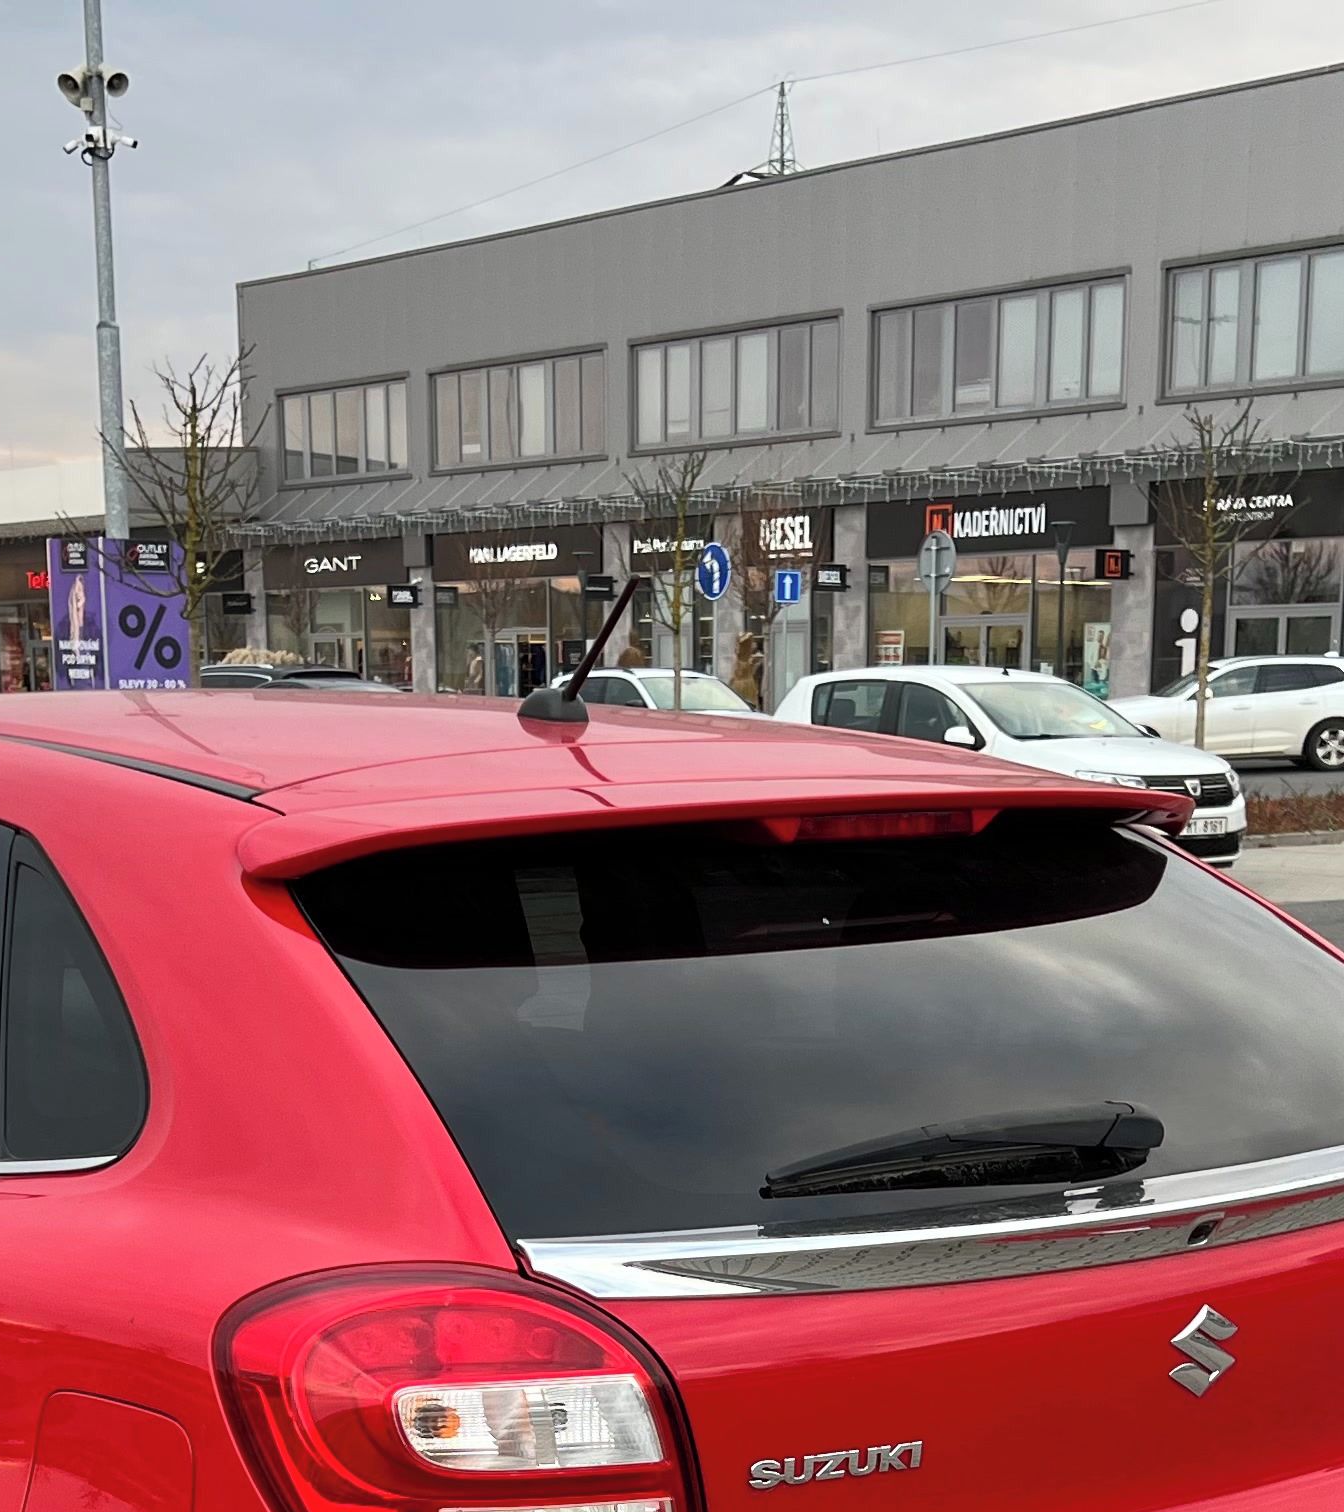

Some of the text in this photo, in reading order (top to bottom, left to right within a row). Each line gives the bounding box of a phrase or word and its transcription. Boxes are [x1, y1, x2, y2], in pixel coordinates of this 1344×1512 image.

[953, 502, 1047, 539] KADEŘNICTVÍ
[1248, 494, 1295, 510] CENTRA
[759, 515, 814, 552] DIESEL
[303, 555, 362, 574] GANT
[497, 543, 558, 562] LAGERFELD
[118, 604, 182, 670] %
[748, 1440, 925, 1491] SUZUKI
